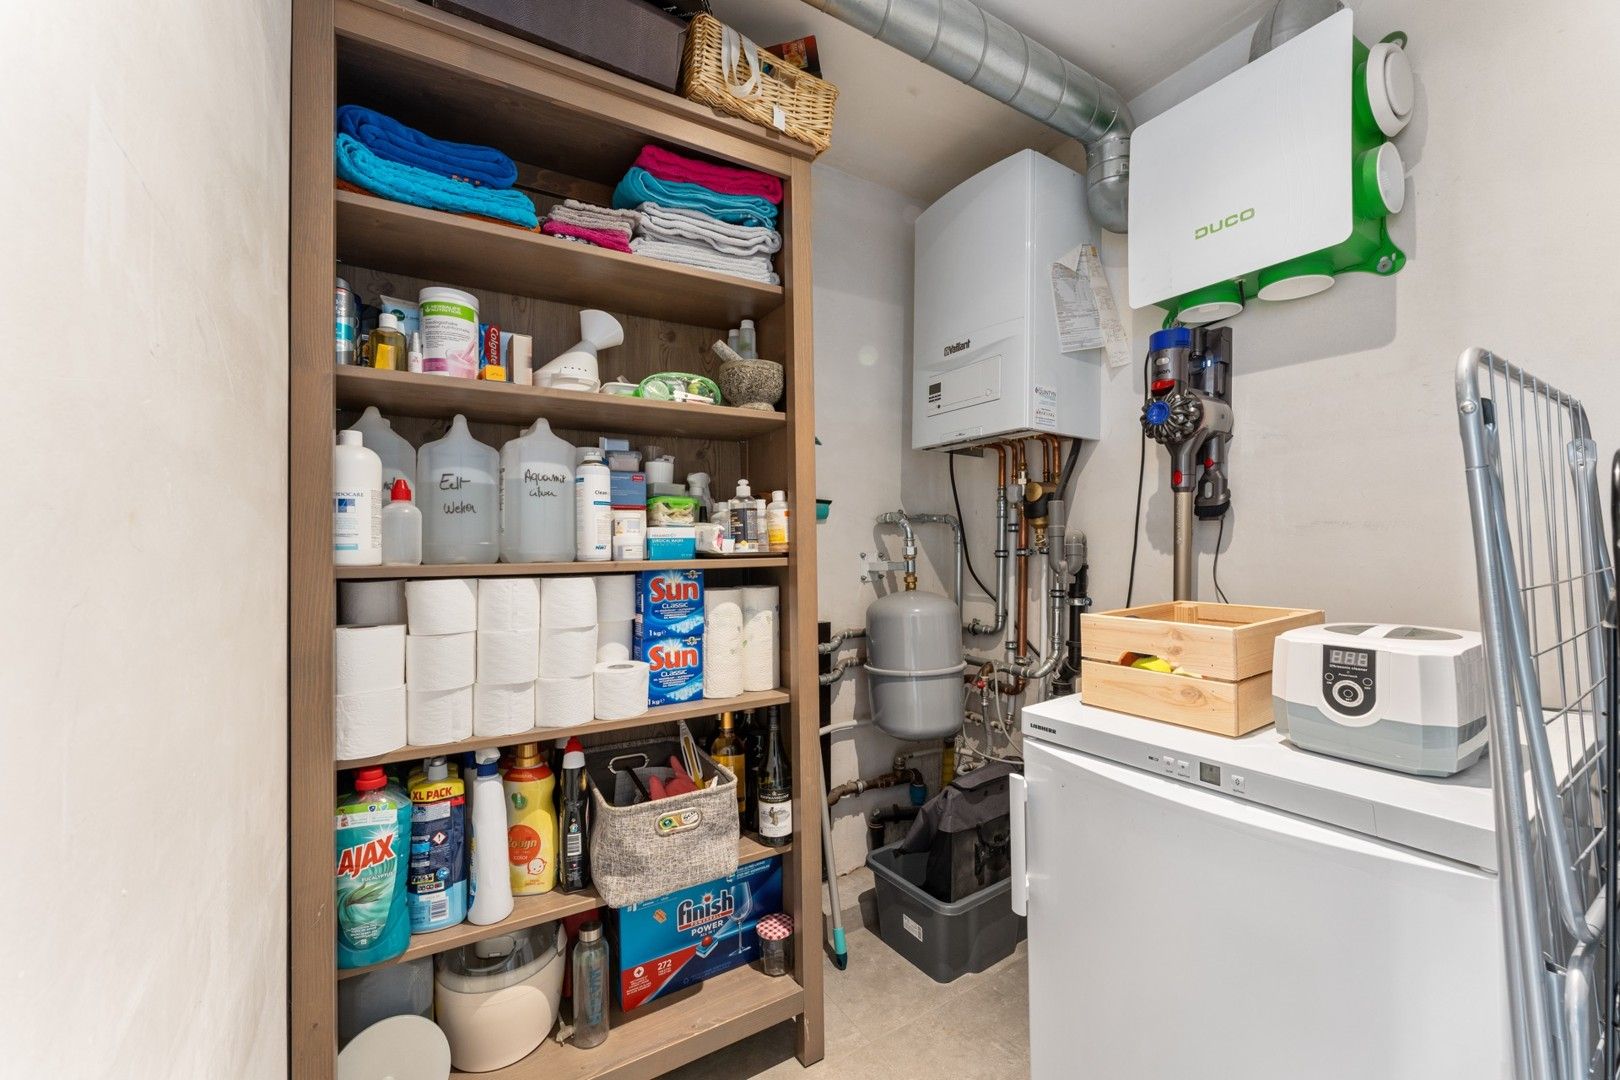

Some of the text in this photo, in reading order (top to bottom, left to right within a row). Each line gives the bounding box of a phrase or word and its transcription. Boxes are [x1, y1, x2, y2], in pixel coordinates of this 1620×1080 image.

[1195, 208, 1255, 240] DUCO
[488, 327, 499, 365] Colgate
[950, 339, 971, 354] Vaillant
[650, 577, 699, 602] Sun
[649, 645, 698, 671] Sun
[1030, 722, 1057, 735] LIEBHERR
[412, 787, 453, 801] XL PACK
[337, 832, 395, 879] AJAX
[677, 890, 734, 926] finish
[691, 920, 724, 937] POWER
[658, 959, 672, 971] 272
